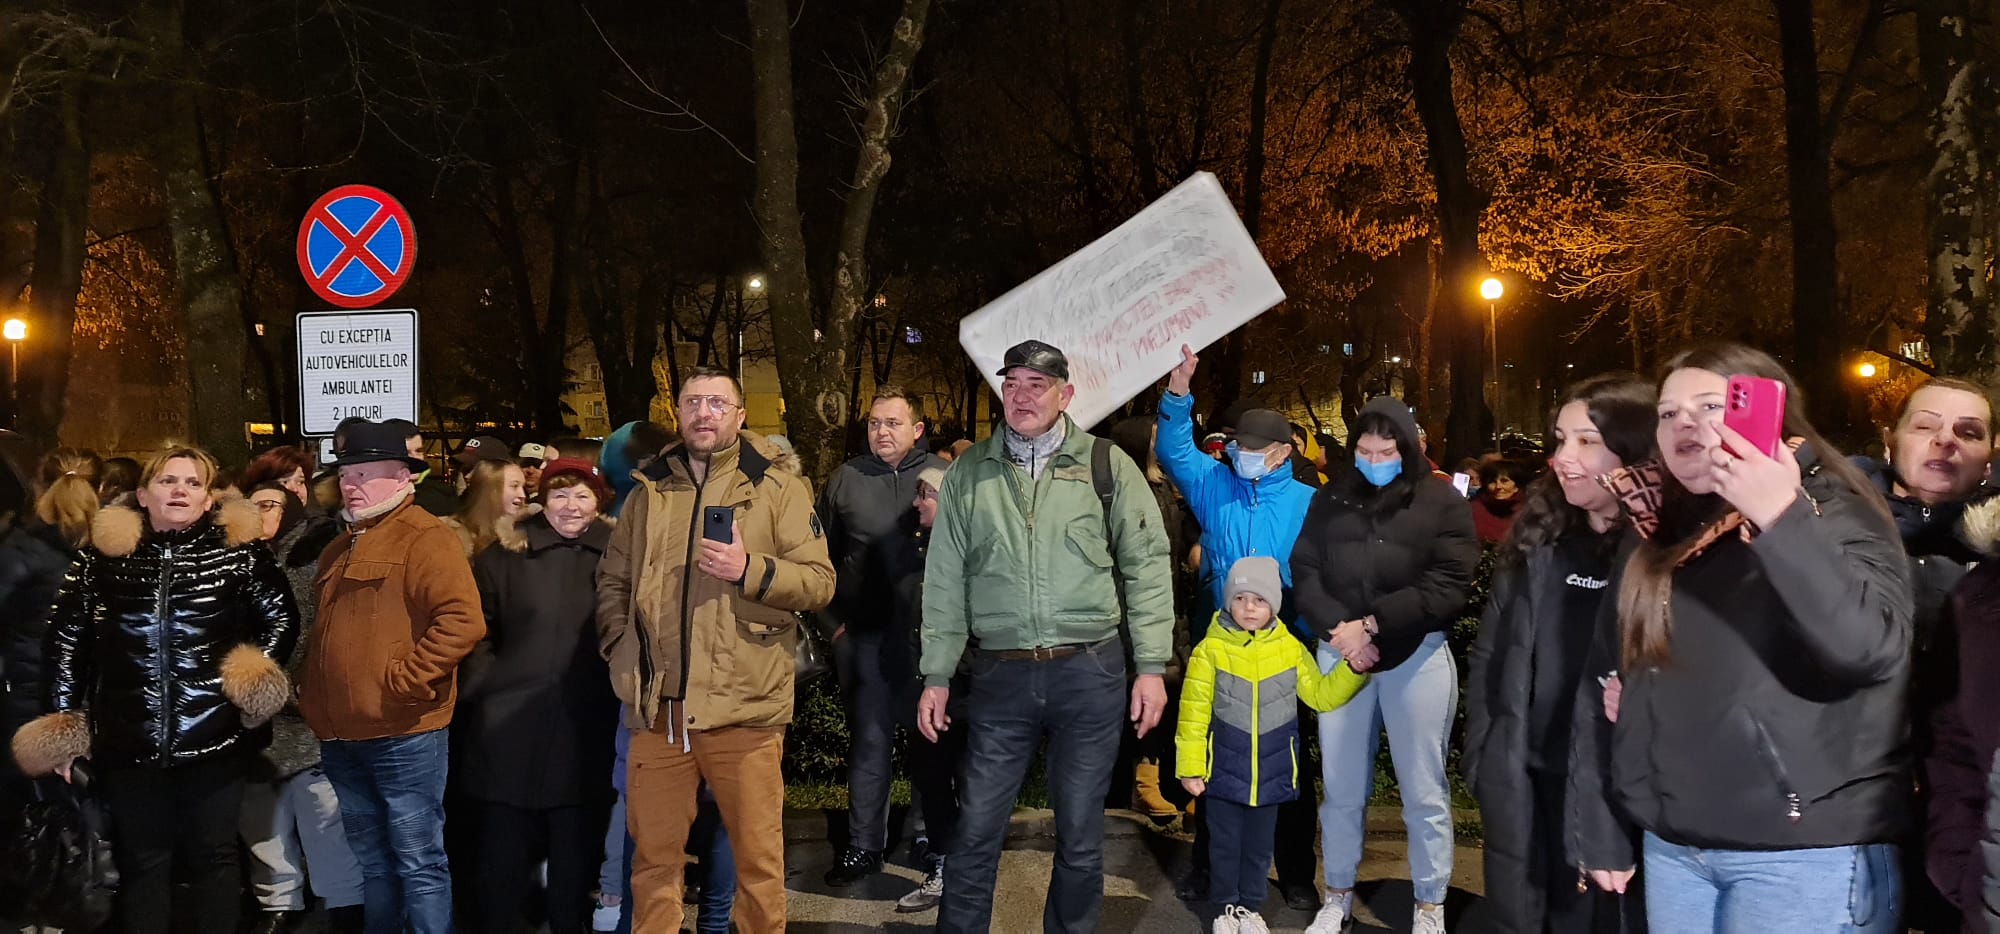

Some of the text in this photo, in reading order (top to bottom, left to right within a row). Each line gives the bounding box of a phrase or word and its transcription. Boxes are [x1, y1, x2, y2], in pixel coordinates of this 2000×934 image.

[320, 328, 392, 345] CU EXCEPȚIA
[305, 353, 408, 370] AUTOVEHICULELOR
[321, 379, 392, 396] AMBULANȚEI
[333, 406, 340, 420] 2
